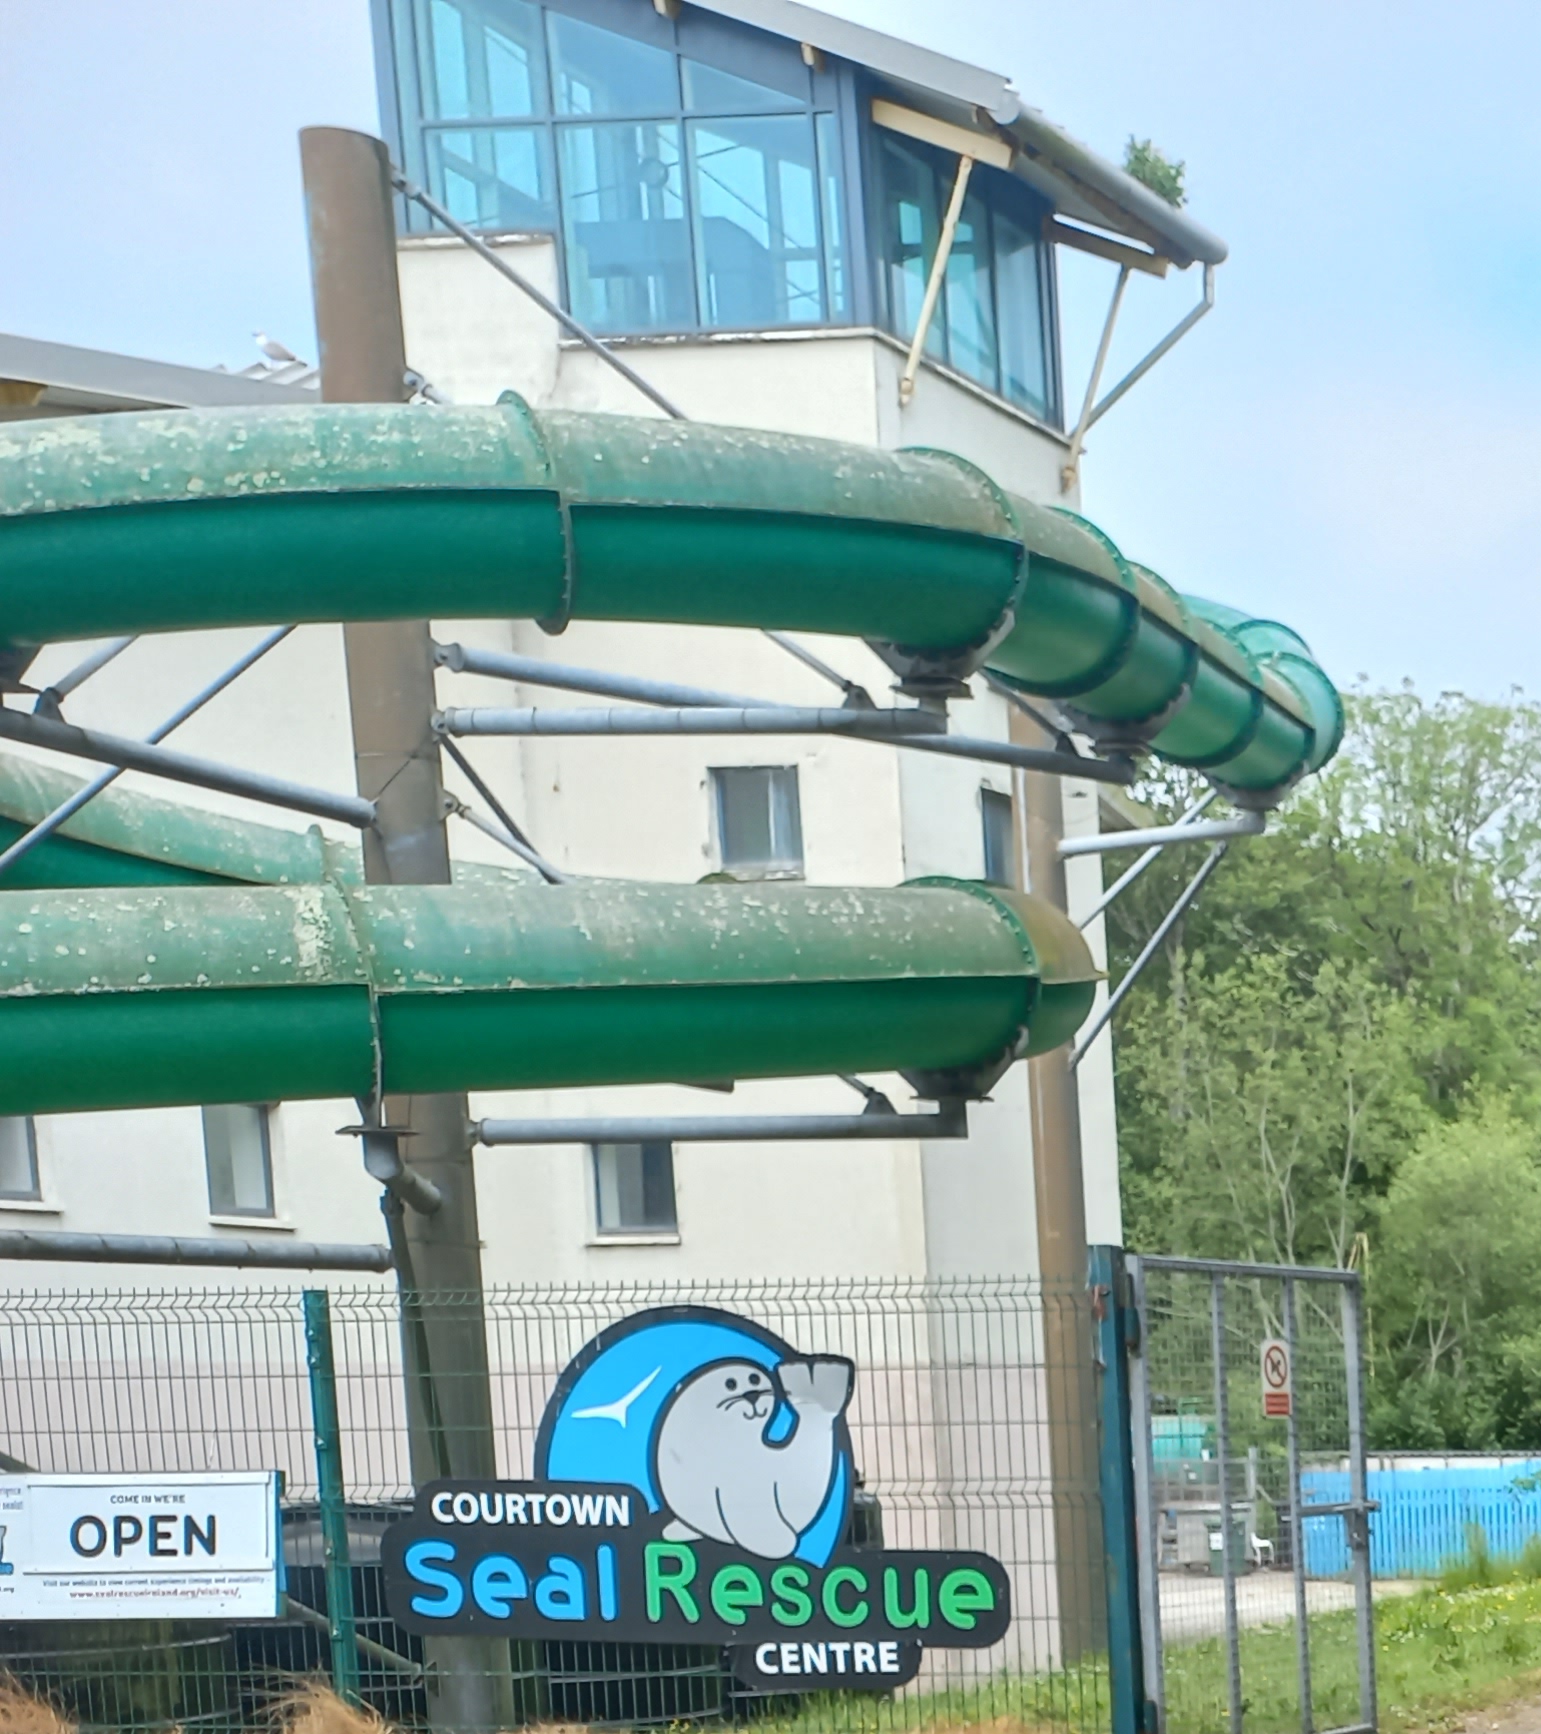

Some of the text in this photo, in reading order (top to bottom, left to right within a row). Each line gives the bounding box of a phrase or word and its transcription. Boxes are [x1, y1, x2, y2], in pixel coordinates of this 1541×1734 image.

[110, 1494, 139, 1504] COME
[141, 1494, 151, 1503] IN
[432, 1492, 630, 1526] COURTOWN
[69, 1514, 216, 1558] OPEN
[405, 1540, 994, 1631] Seal Rescue
[755, 1641, 899, 1674] CENTRE
